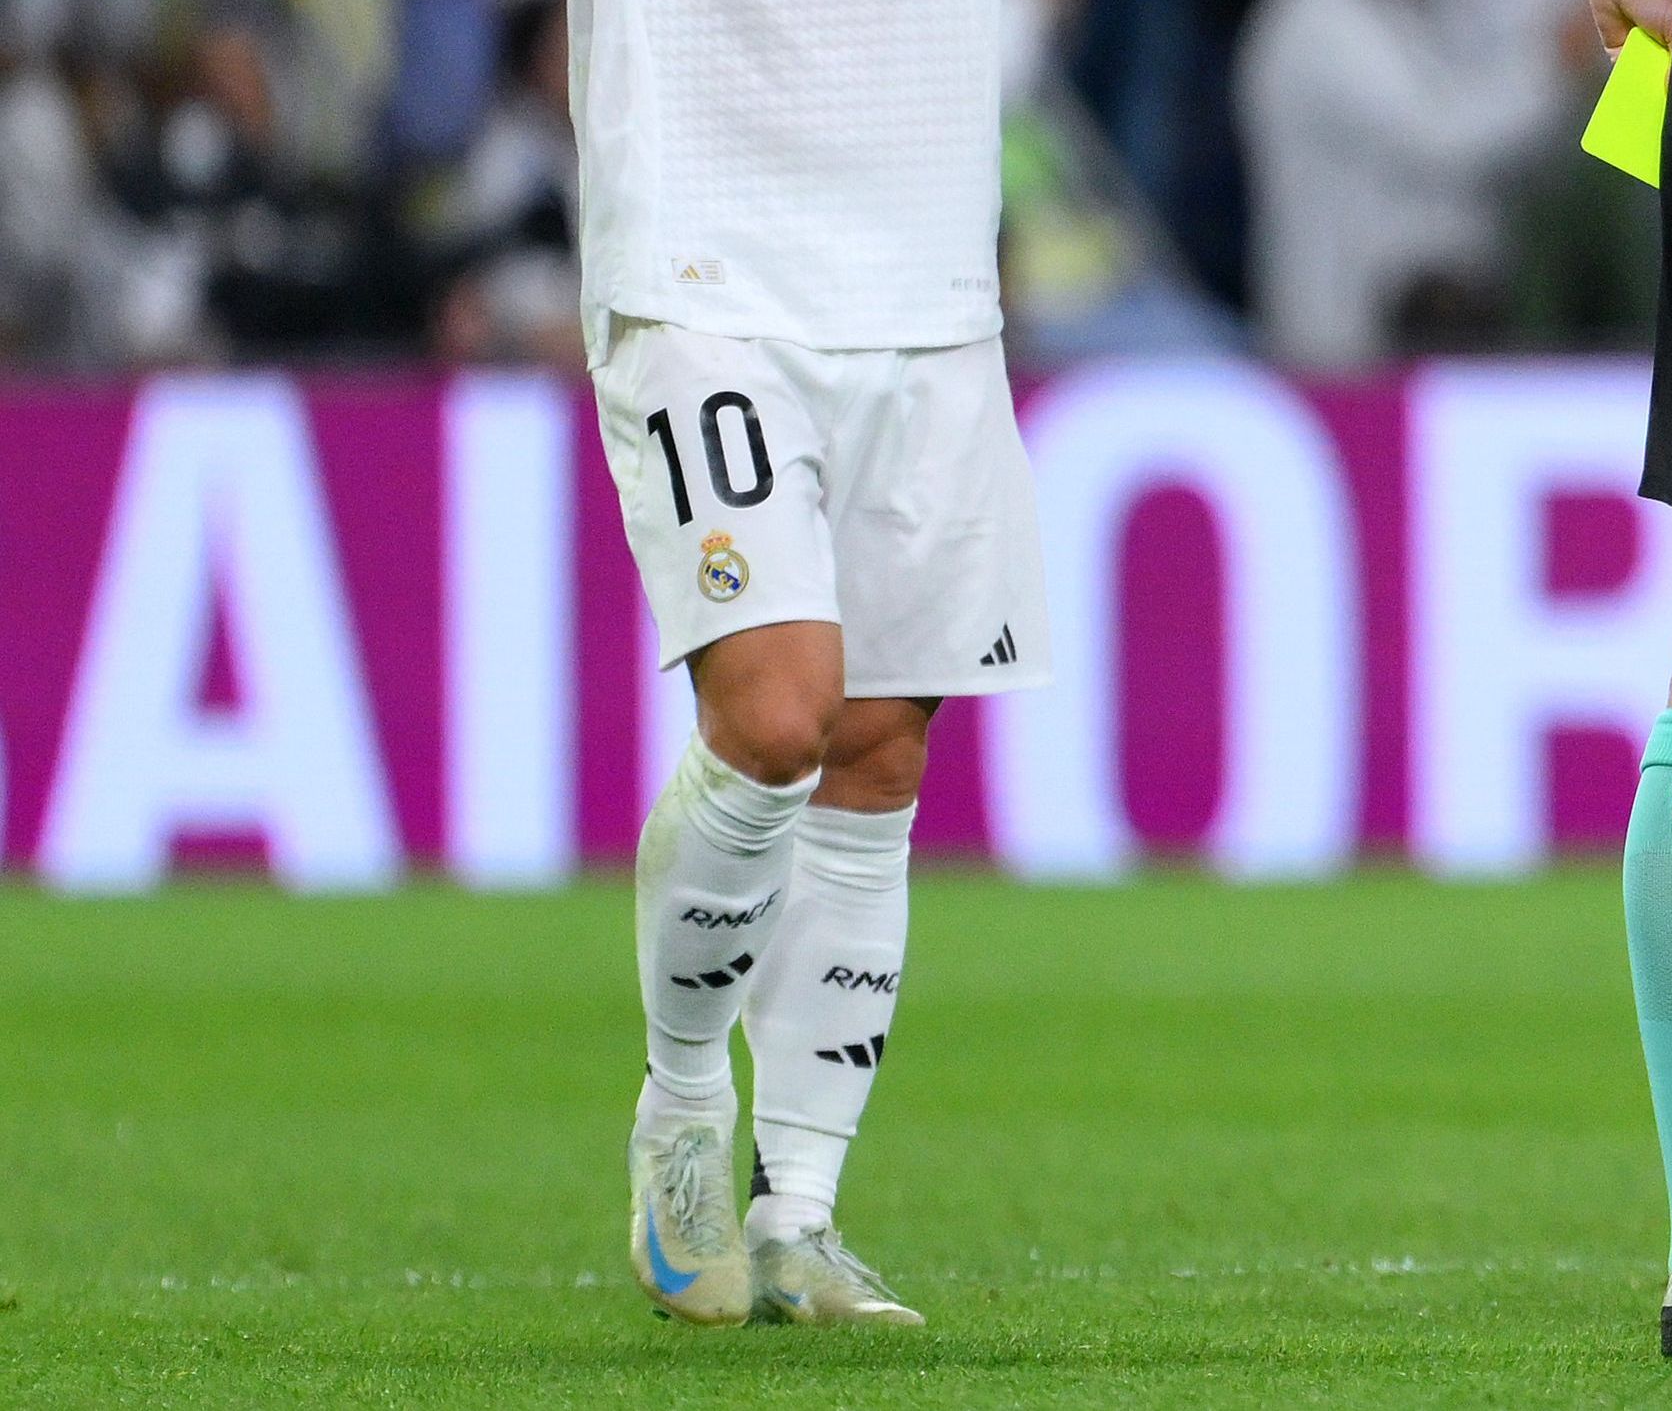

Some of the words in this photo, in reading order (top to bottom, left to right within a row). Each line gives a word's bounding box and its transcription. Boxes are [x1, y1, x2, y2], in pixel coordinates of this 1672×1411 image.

[646, 390, 775, 528] 10
[679, 887, 781, 931] RMCF
[821, 965, 899, 994] RMC
